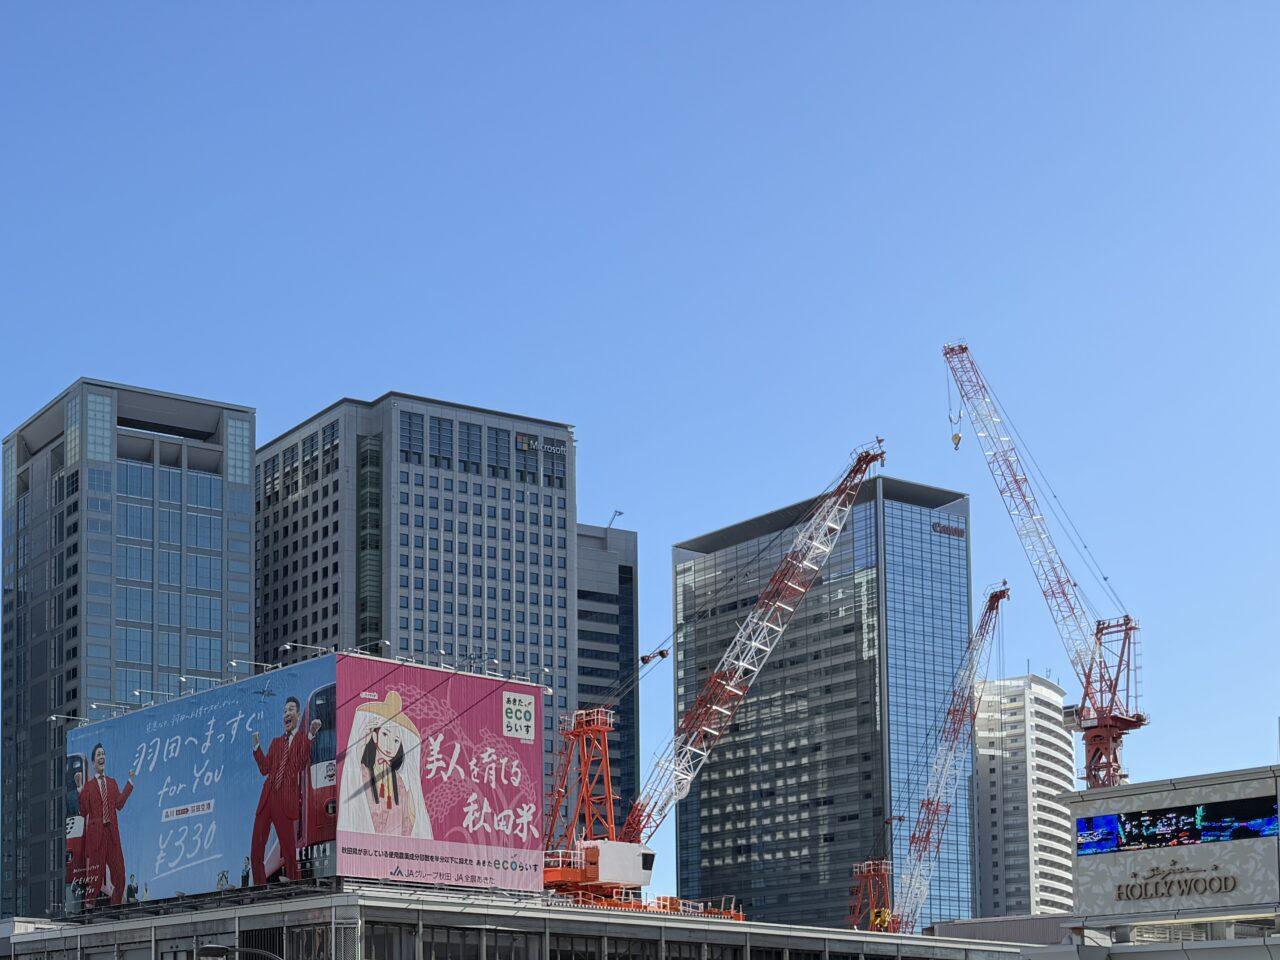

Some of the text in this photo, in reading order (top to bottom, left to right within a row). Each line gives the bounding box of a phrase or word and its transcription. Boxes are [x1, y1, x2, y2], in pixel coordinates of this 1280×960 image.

[530, 440, 568, 455] Microsoft
[505, 707, 532, 722] eco
[506, 721, 531, 735] らいす
[133, 710, 264, 775] 羽田へまっすぐ
[425, 733, 522, 789] 美人を育てる
[158, 775, 186, 807] for
[463, 792, 540, 842] 秋田米
[295, 843, 331, 861] KEIKYU
[1115, 875, 1237, 902] HOLLYWOOD
